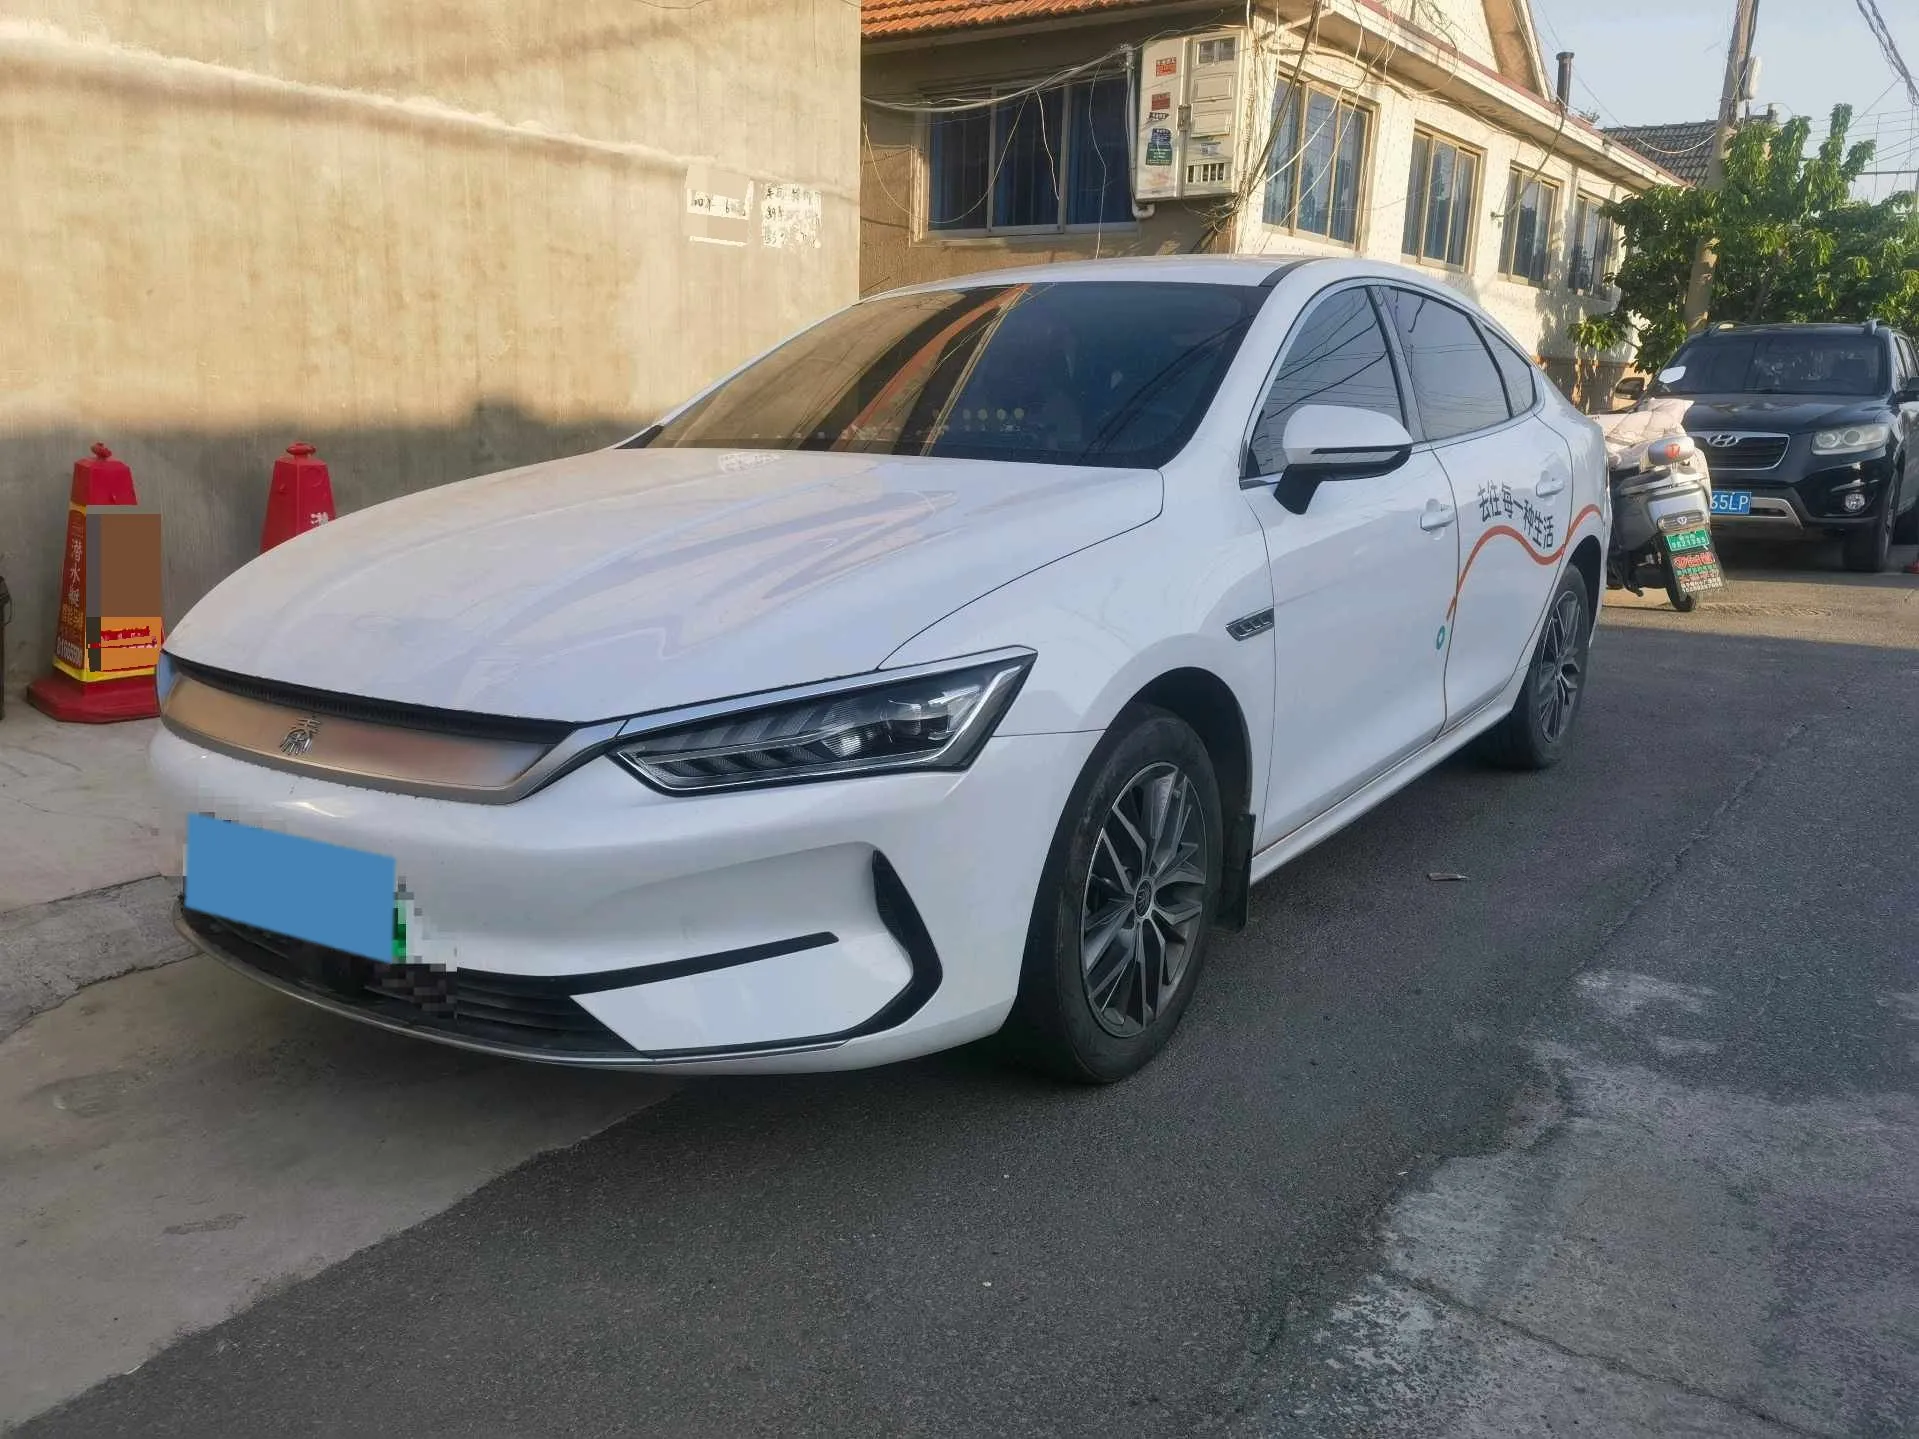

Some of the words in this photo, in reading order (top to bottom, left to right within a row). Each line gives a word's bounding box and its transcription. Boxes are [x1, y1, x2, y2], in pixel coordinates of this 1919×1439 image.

[1478, 480, 1554, 549] 去往每一种生活
